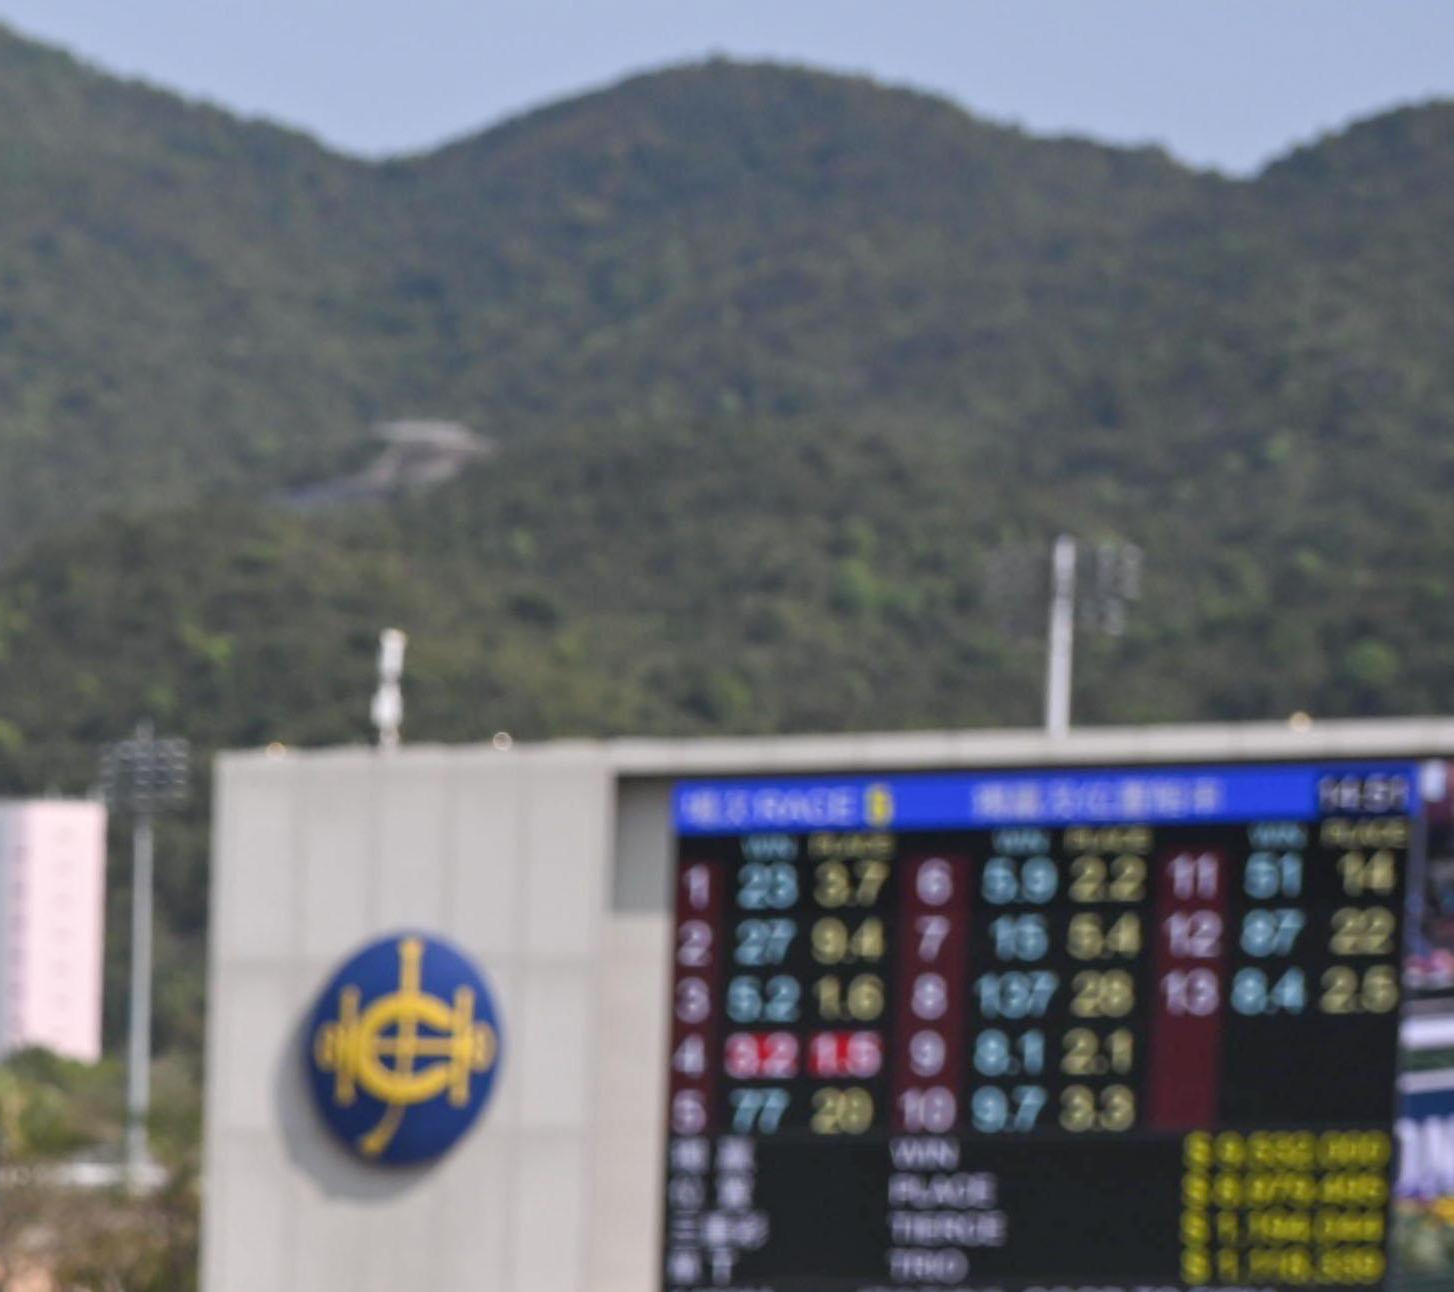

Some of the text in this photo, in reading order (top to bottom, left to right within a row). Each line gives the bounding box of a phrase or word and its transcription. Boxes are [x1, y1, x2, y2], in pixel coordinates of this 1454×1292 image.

[683, 863, 710, 910] 1
[1167, 852, 1219, 899] 11
[1337, 850, 1395, 897] 14
[679, 919, 713, 966] 2
[736, 918, 797, 966] 27
[915, 914, 951, 962] 7
[1162, 909, 1224, 958] 12
[1330, 906, 1397, 955] 22
[1160, 967, 1221, 1016] 13
[673, 1033, 706, 1078] 4
[1061, 1027, 1134, 1076] 2.1
[729, 1087, 790, 1134] 77
